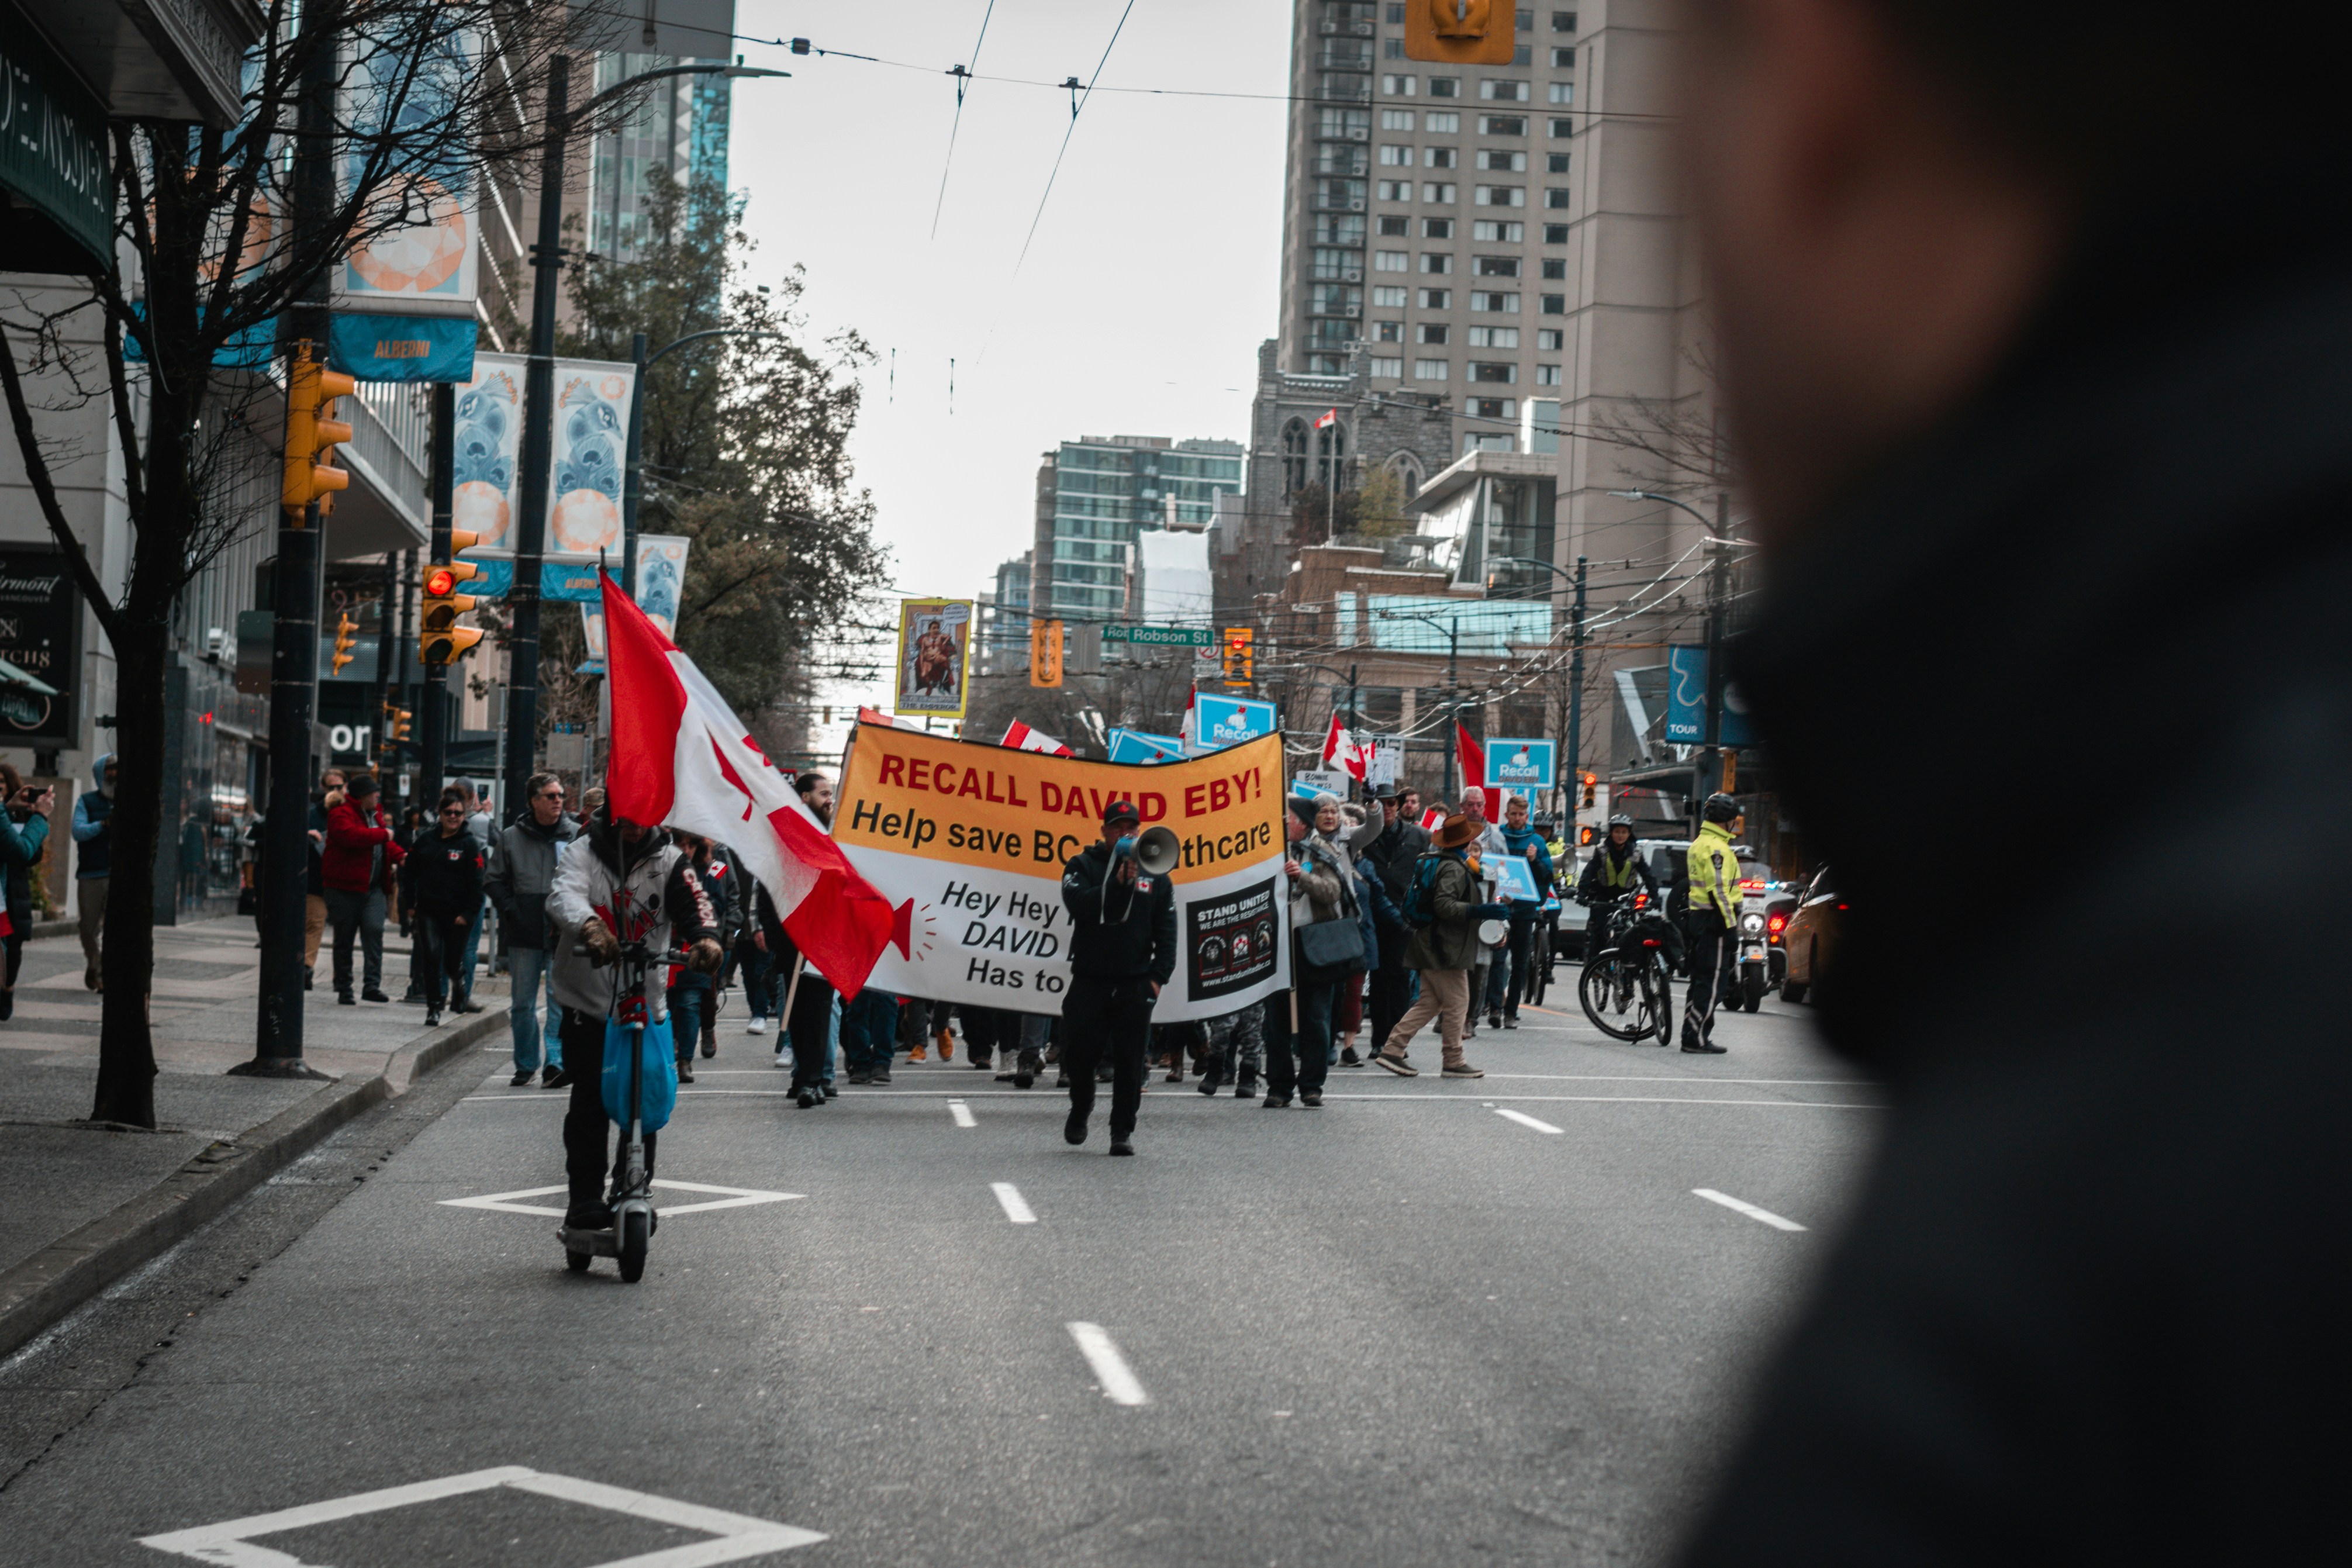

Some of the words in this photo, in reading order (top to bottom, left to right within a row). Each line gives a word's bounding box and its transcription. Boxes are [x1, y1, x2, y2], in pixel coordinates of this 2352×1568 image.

[374, 340, 431, 358] ALBERNI
[1133, 628, 1187, 643] Robson
[1192, 631, 1208, 644] St
[1213, 723, 1258, 740] Recall
[1670, 724, 1698, 734] TOUR
[1498, 775, 1523, 783] DAVID
[1524, 775, 1541, 783] EBY
[1500, 764, 1540, 776] Recall
[878, 753, 1028, 808] RECALL
[1184, 766, 1262, 818] EBY!
[851, 799, 937, 849] Help
[947, 823, 1023, 858] save
[1033, 829, 1080, 866] BC
[940, 880, 1002, 918] Hey
[1007, 890, 1061, 929] Hey
[1197, 903, 1237, 922] STAND
[1239, 889, 1270, 911] UNITED
[1199, 921, 1212, 931] WE
[1213, 917, 1227, 928] ARE
[1227, 913, 1239, 925] THE
[961, 920, 1059, 958] DAVID
[966, 956, 1024, 989] Has
[1035, 968, 1065, 993] to
